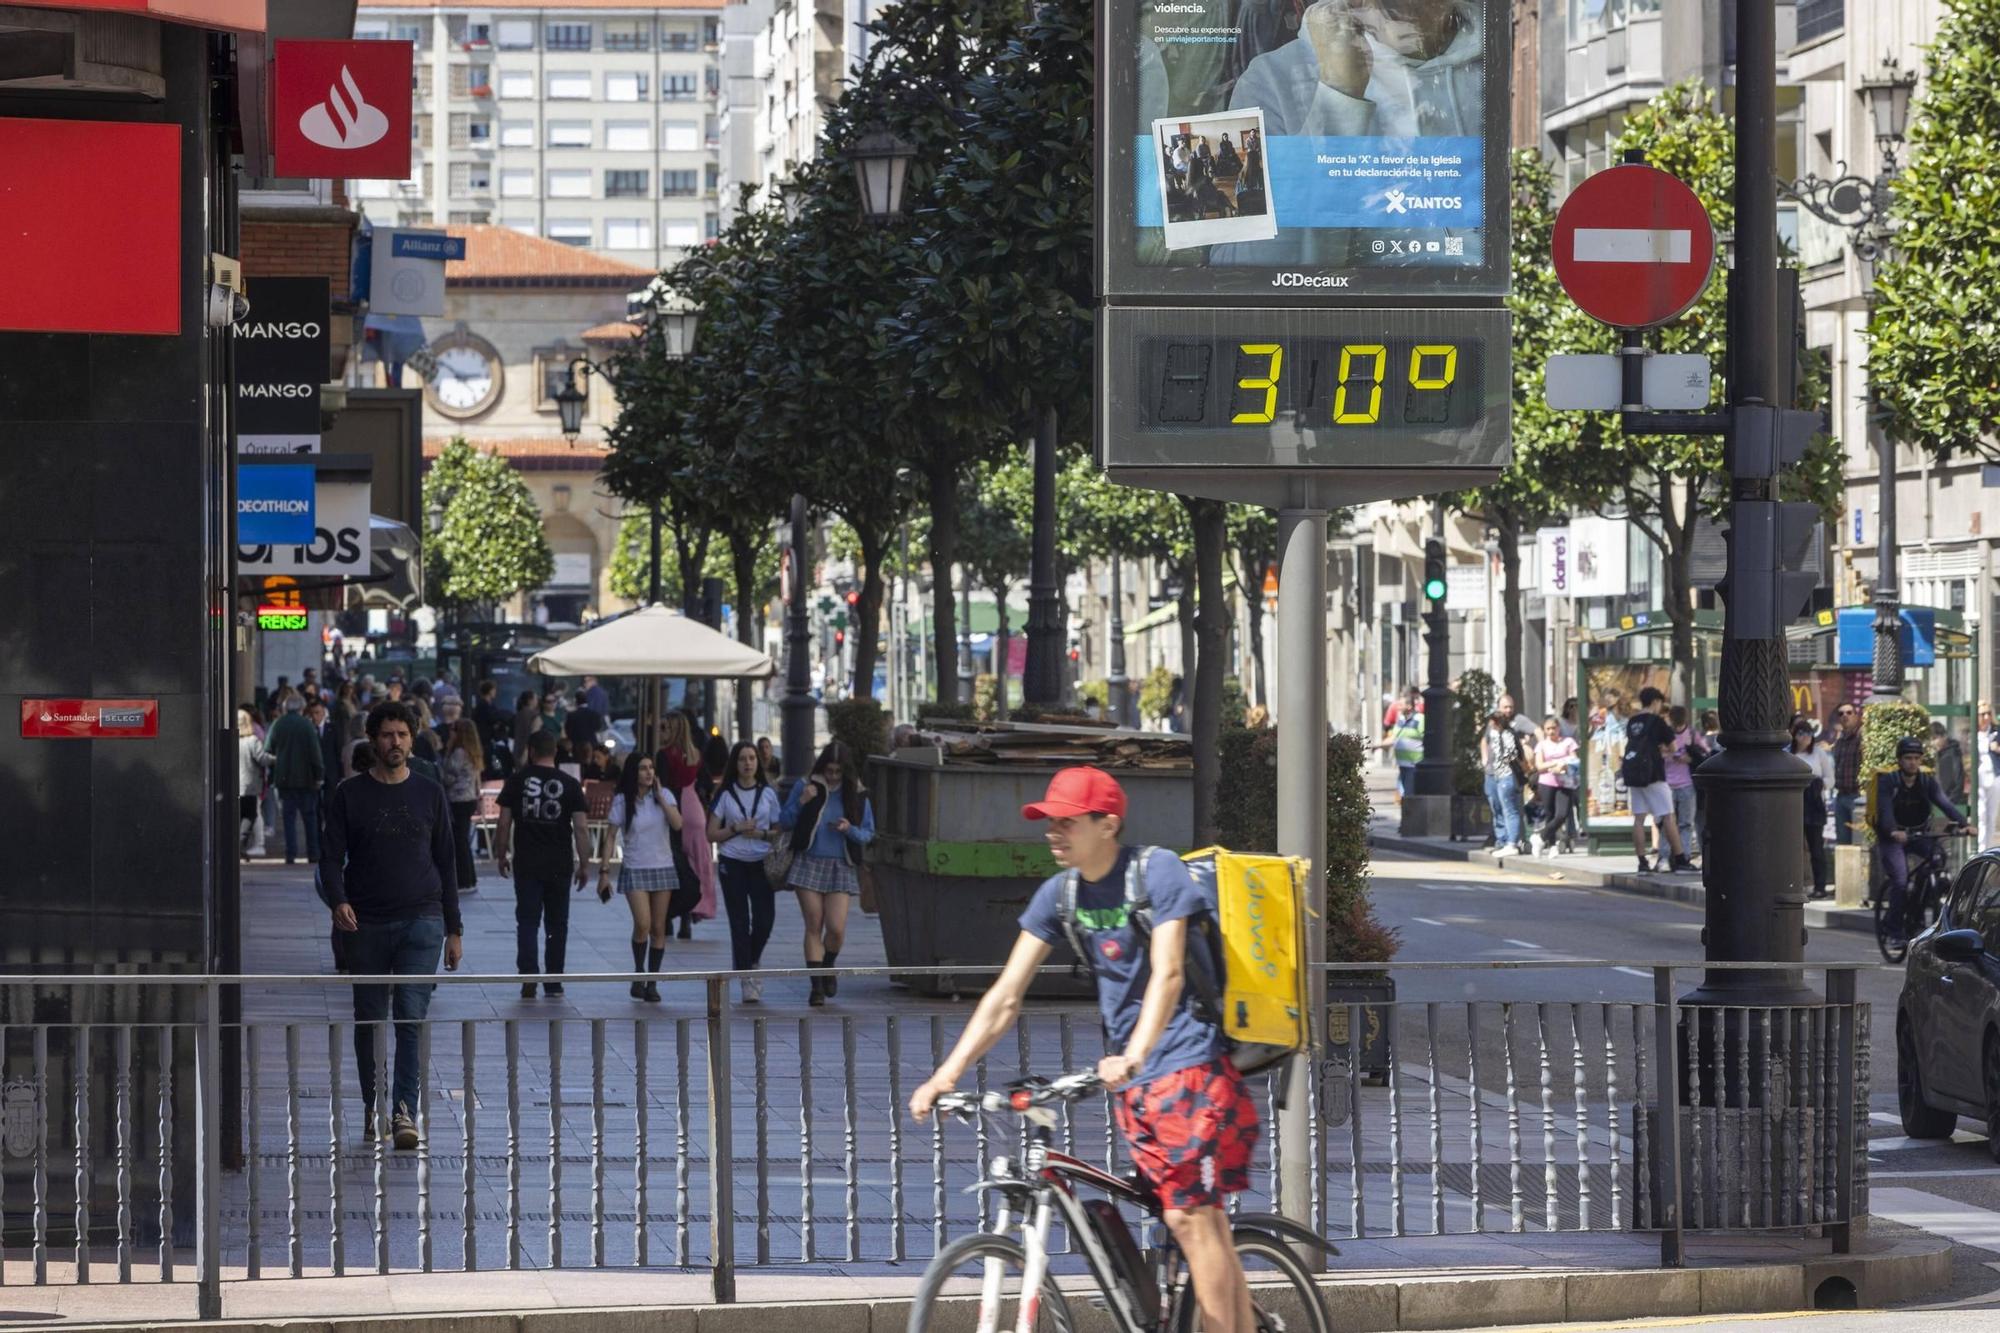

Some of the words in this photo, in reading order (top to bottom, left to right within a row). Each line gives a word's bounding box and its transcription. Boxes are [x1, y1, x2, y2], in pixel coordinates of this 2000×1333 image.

[1154, 2, 1206, 13] violencia.
[1154, 26, 1190, 34] Descubre
[1200, 26, 1242, 35] experiencia
[1166, 35, 1238, 44] unviajeportantos.es
[1317, 155, 1347, 164] Marca
[1348, 155, 1356, 164] la
[1381, 155, 1404, 164] favor
[1406, 155, 1418, 164] de
[1420, 155, 1429, 164] la
[1431, 155, 1462, 166] Iglesia
[1328, 169, 1341, 177] en
[1342, 169, 1352, 177] tu
[1354, 168, 1407, 177] declaración
[1409, 168, 1421, 177] de
[1423, 168, 1432, 177] la
[1434, 169, 1462, 177] renta.
[402, 239, 441, 252] Allianz
[1271, 273, 1349, 288] JCDecaux
[232, 322, 320, 338] MANGO
[239, 384, 312, 398] MANGO
[237, 499, 309, 513] DECATHLON
[53, 712, 96, 722] Santander
[523, 776, 564, 799] SO
[521, 797, 562, 820] HO
